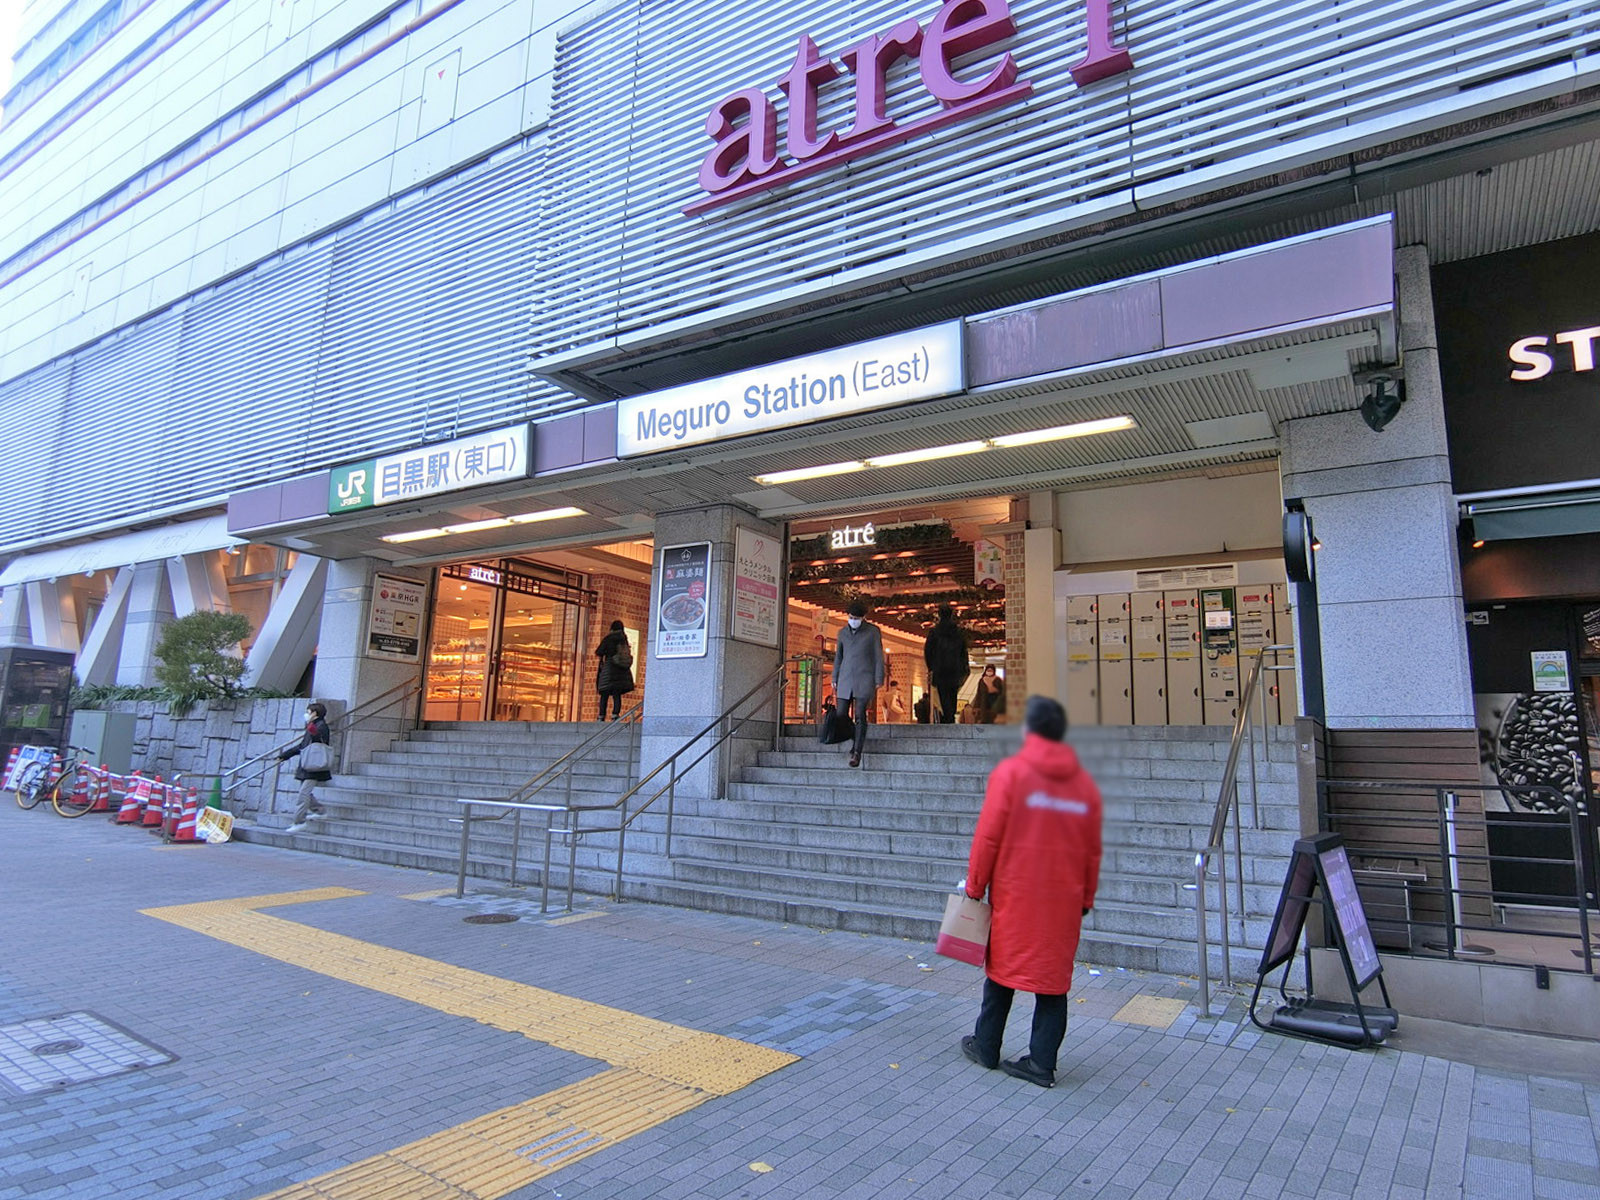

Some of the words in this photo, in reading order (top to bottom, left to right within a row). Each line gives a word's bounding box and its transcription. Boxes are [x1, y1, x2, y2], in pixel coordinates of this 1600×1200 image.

[636, 399, 731, 440] Meguro
[743, 373, 846, 418] Station
[852, 345, 930, 396] (East)
[337, 469, 366, 499] JR
[831, 522, 876, 548] atré
